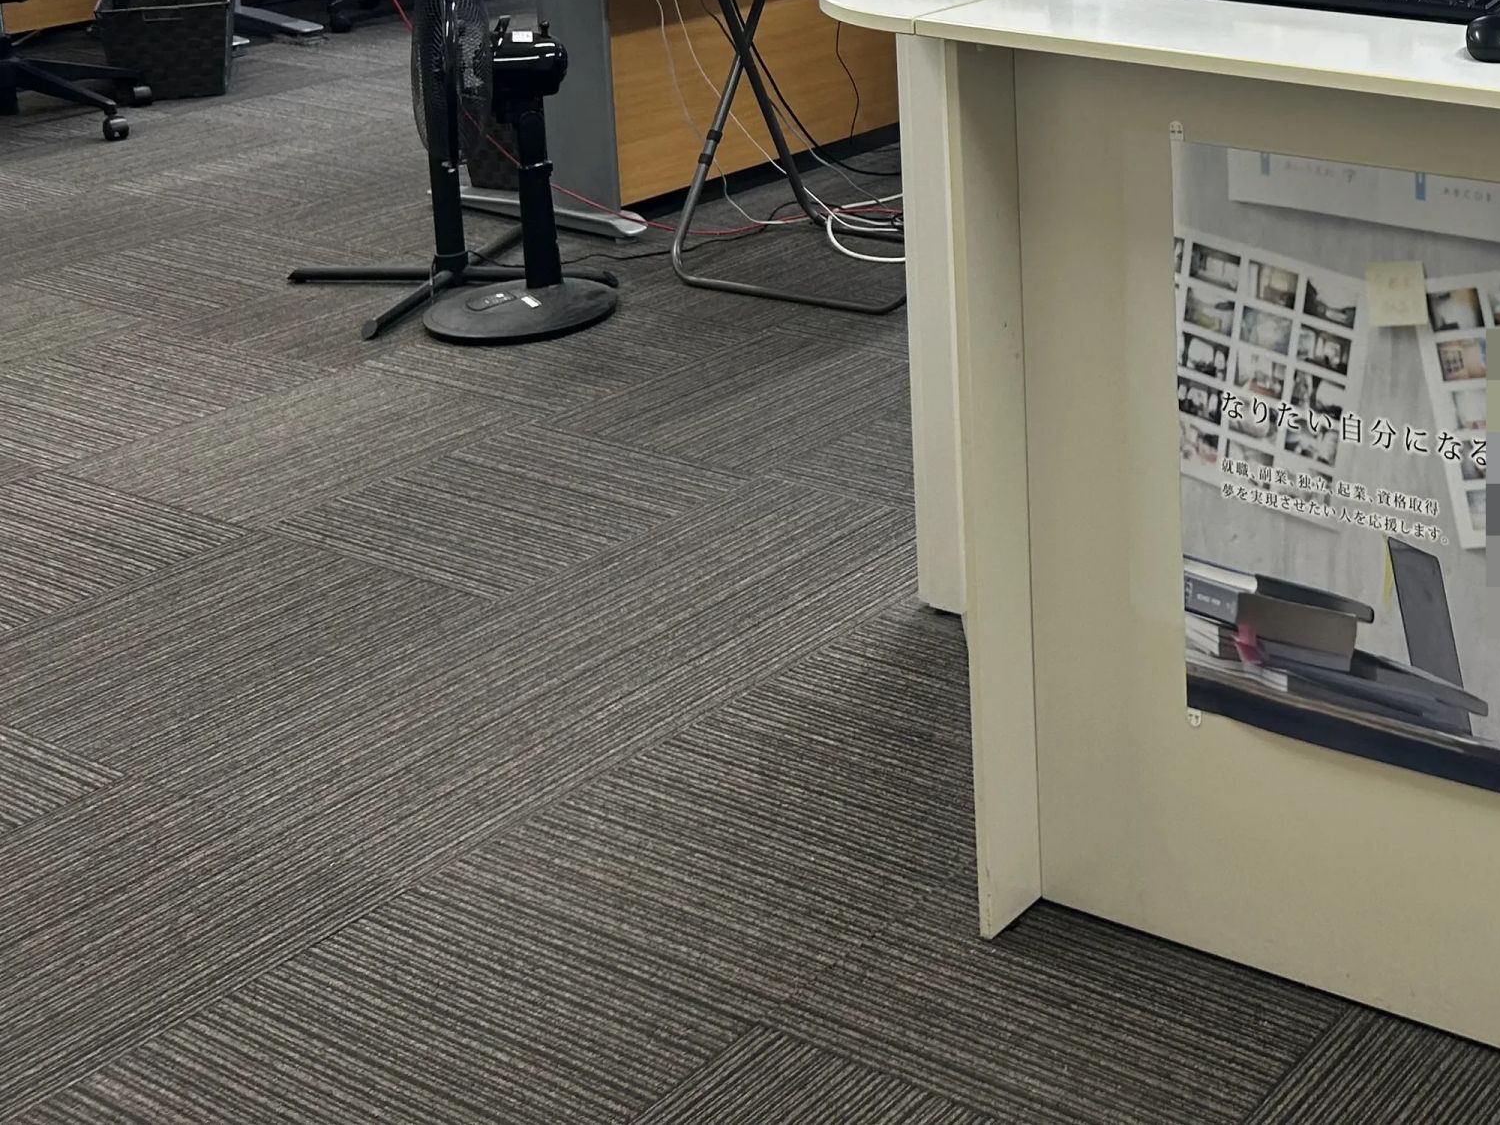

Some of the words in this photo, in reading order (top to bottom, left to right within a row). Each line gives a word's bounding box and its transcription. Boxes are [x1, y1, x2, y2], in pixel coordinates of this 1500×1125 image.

[1221, 457, 1440, 516] 就職、副業、独立、起業、資格取得
[1221, 483, 1449, 545] 夢を実現させたい人を応援します。
